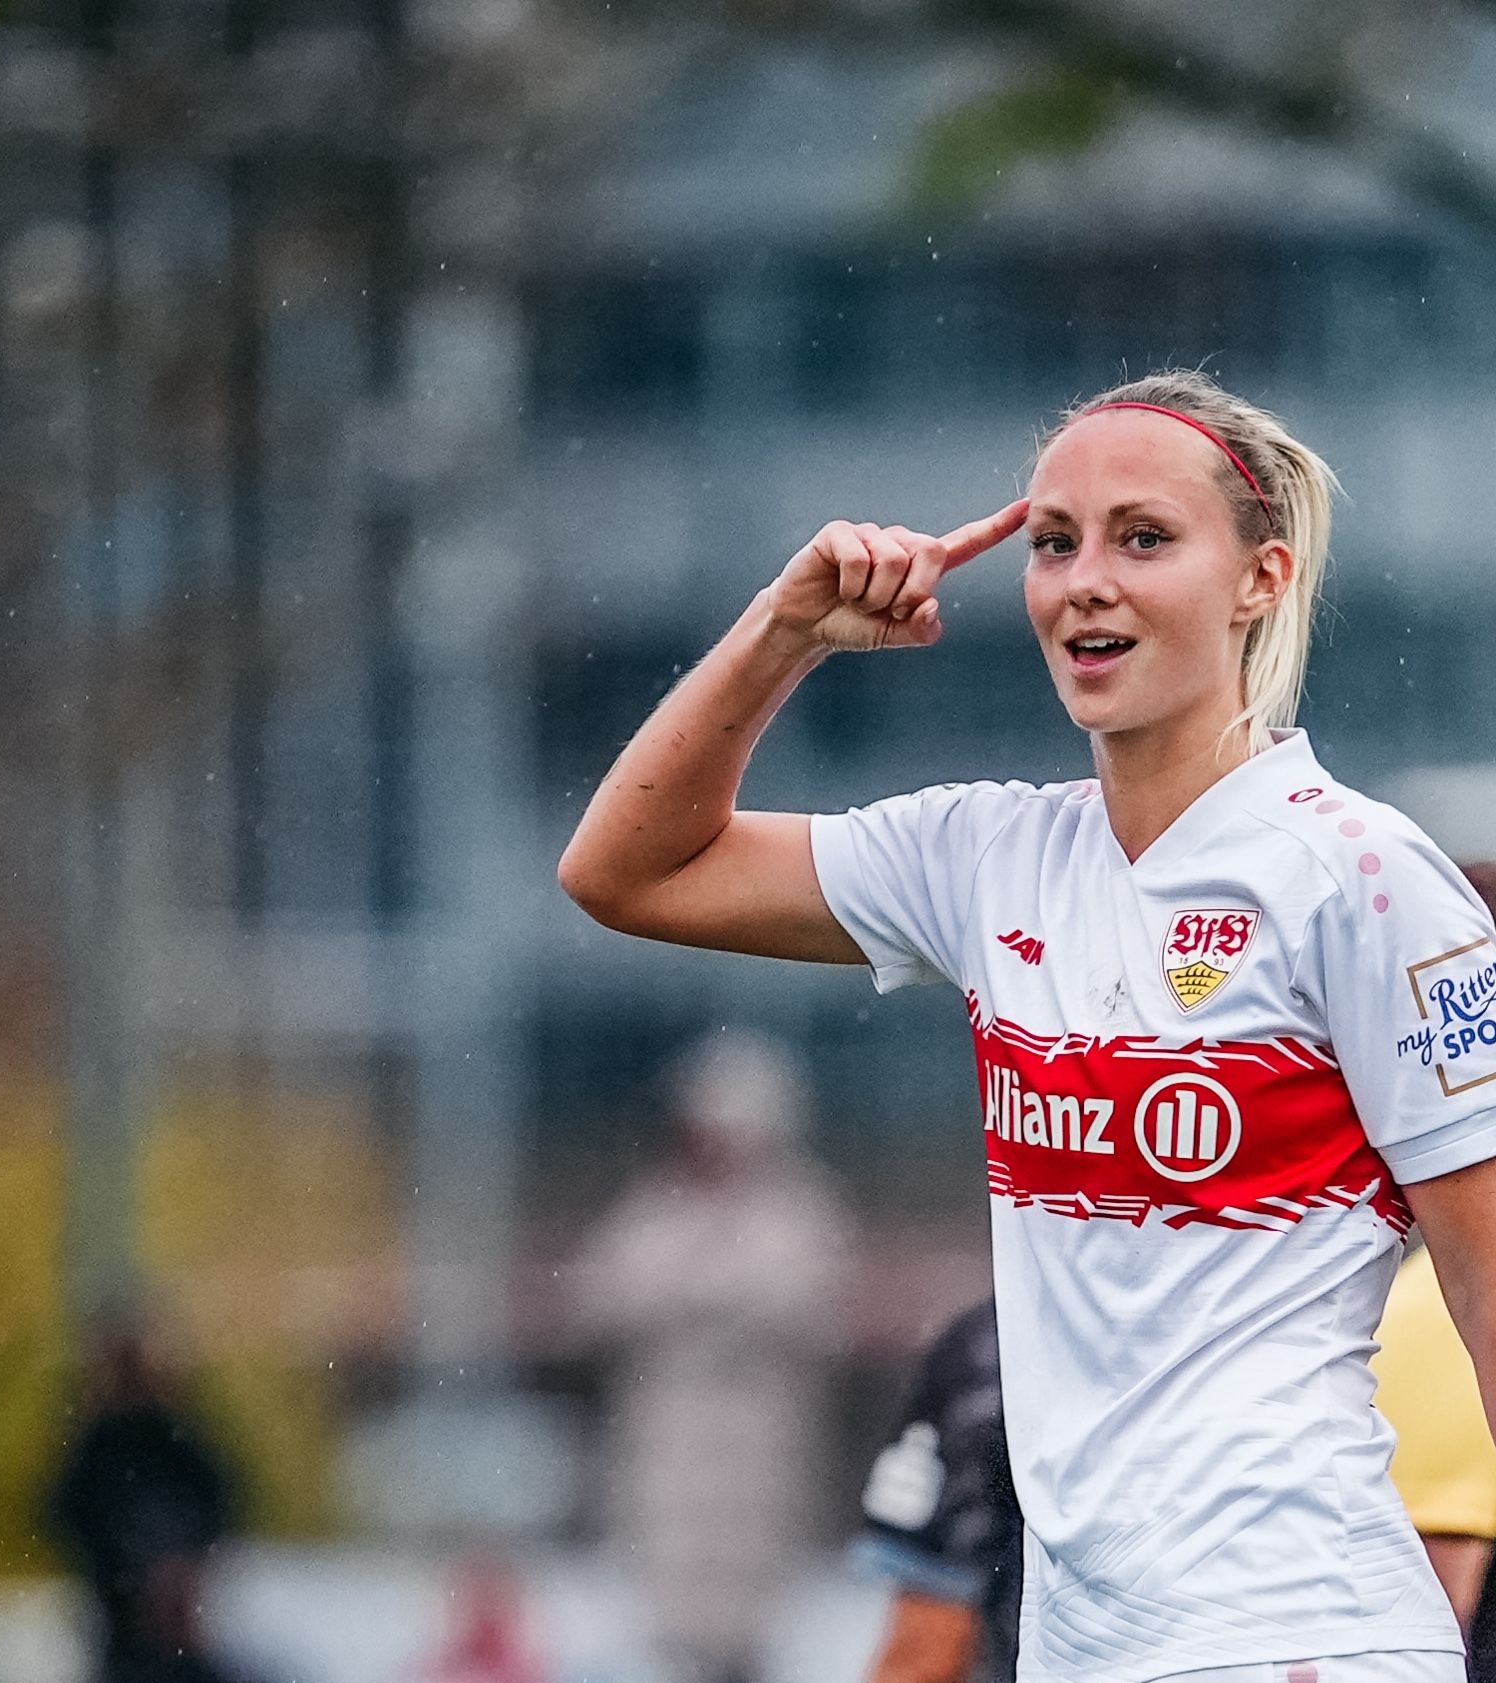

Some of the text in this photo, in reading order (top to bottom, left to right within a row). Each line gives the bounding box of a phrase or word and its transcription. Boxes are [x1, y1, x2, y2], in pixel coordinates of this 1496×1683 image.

[997, 929, 1045, 966] JAK
[1397, 1026, 1438, 1066] my
[983, 1058, 1115, 1155] Allianz
